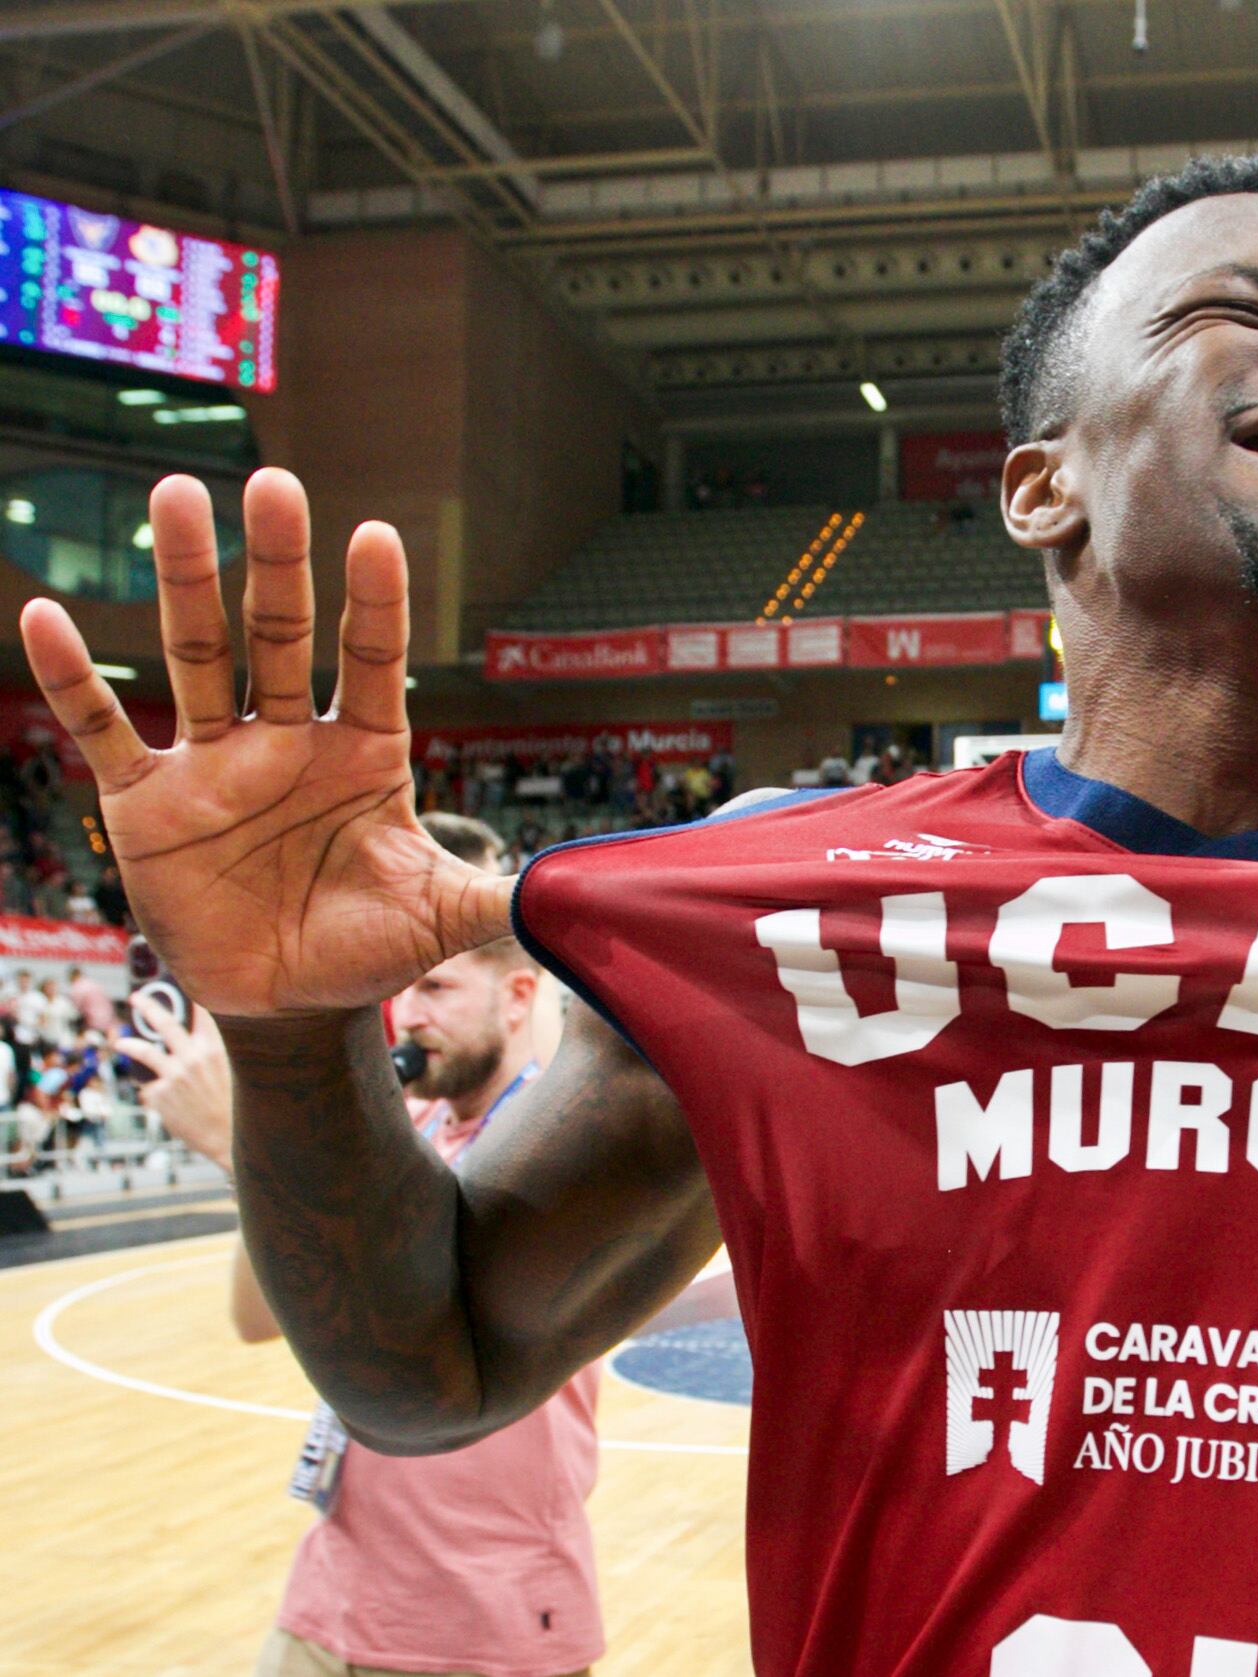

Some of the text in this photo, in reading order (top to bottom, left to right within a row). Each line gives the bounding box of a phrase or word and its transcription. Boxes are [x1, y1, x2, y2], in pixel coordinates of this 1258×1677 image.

[427, 735, 589, 760] Ayntamiento
[628, 729, 711, 752] Murcia
[1083, 1377, 1137, 1415] DE
[1144, 1377, 1195, 1420] LA
[1073, 1422, 1165, 1474] AÑO
